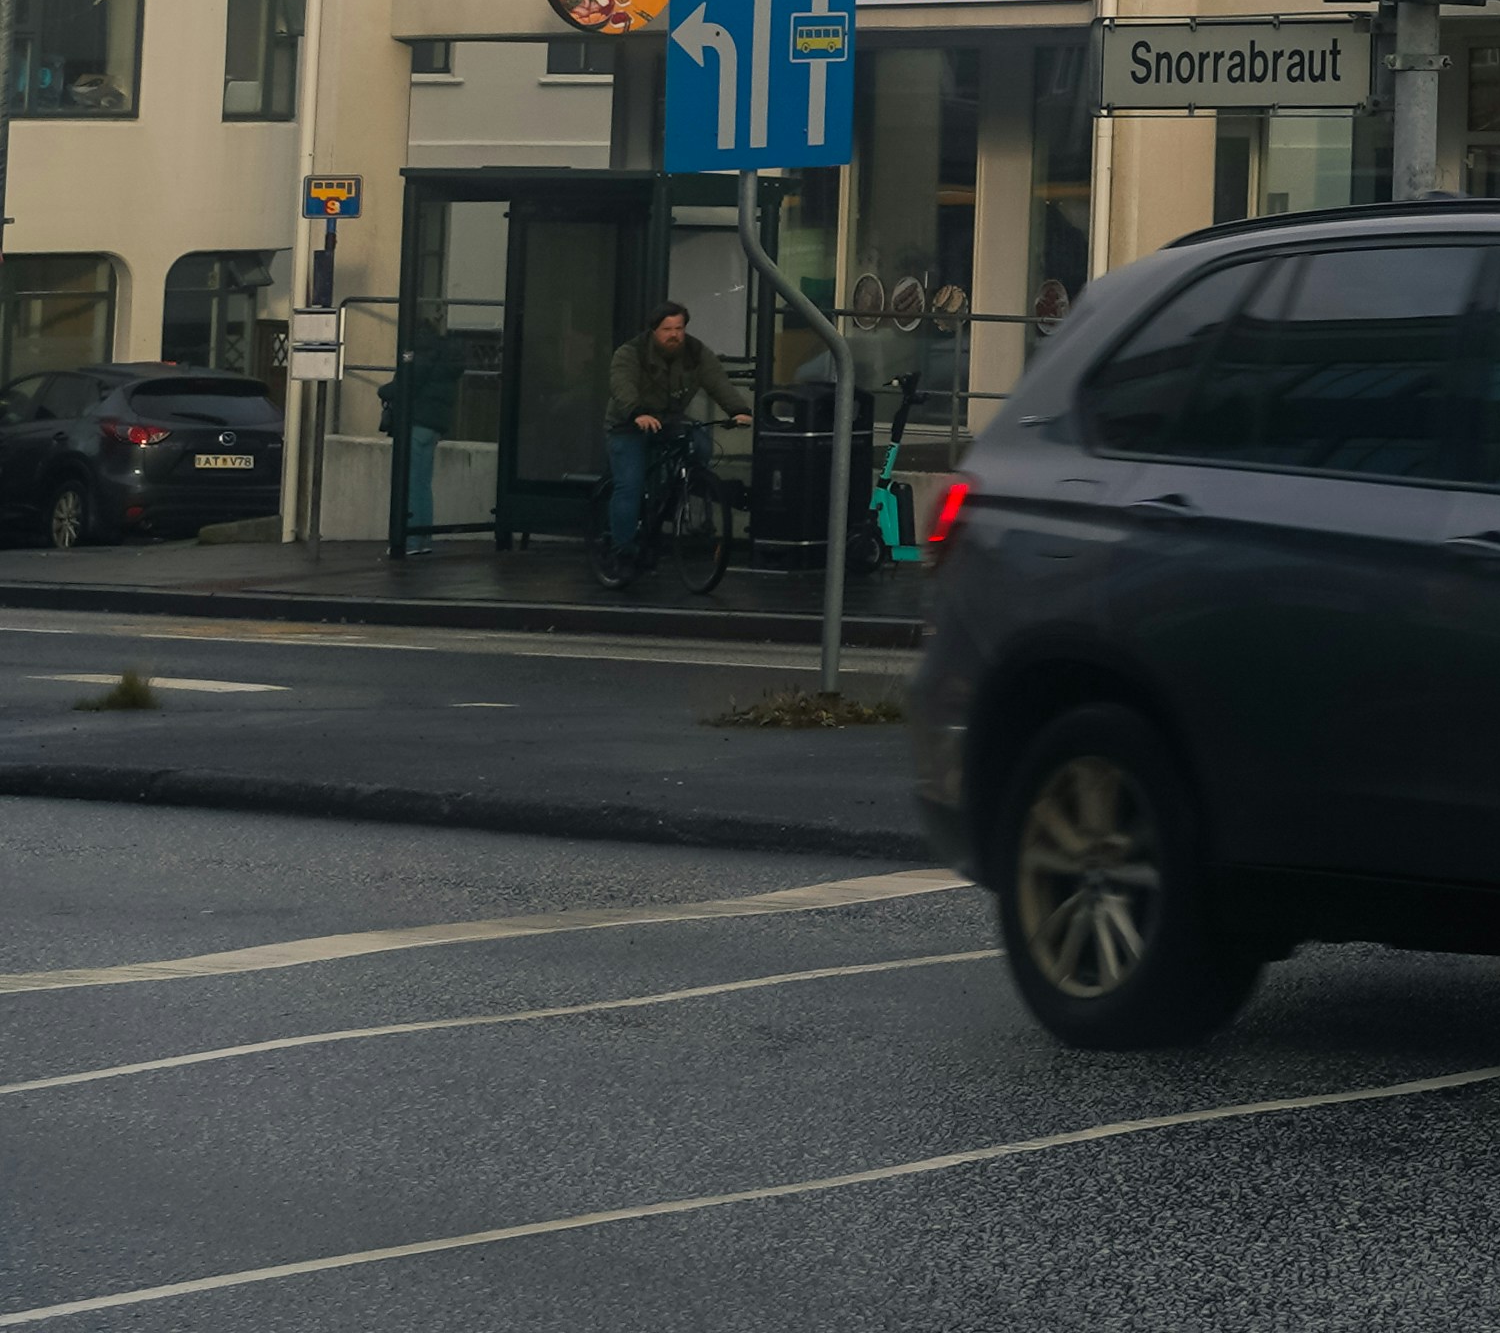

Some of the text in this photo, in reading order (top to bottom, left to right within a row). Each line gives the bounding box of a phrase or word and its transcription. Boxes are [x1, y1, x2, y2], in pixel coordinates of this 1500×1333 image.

[1130, 37, 1342, 85] Snorrabraut
[203, 457, 251, 466] AT V78
